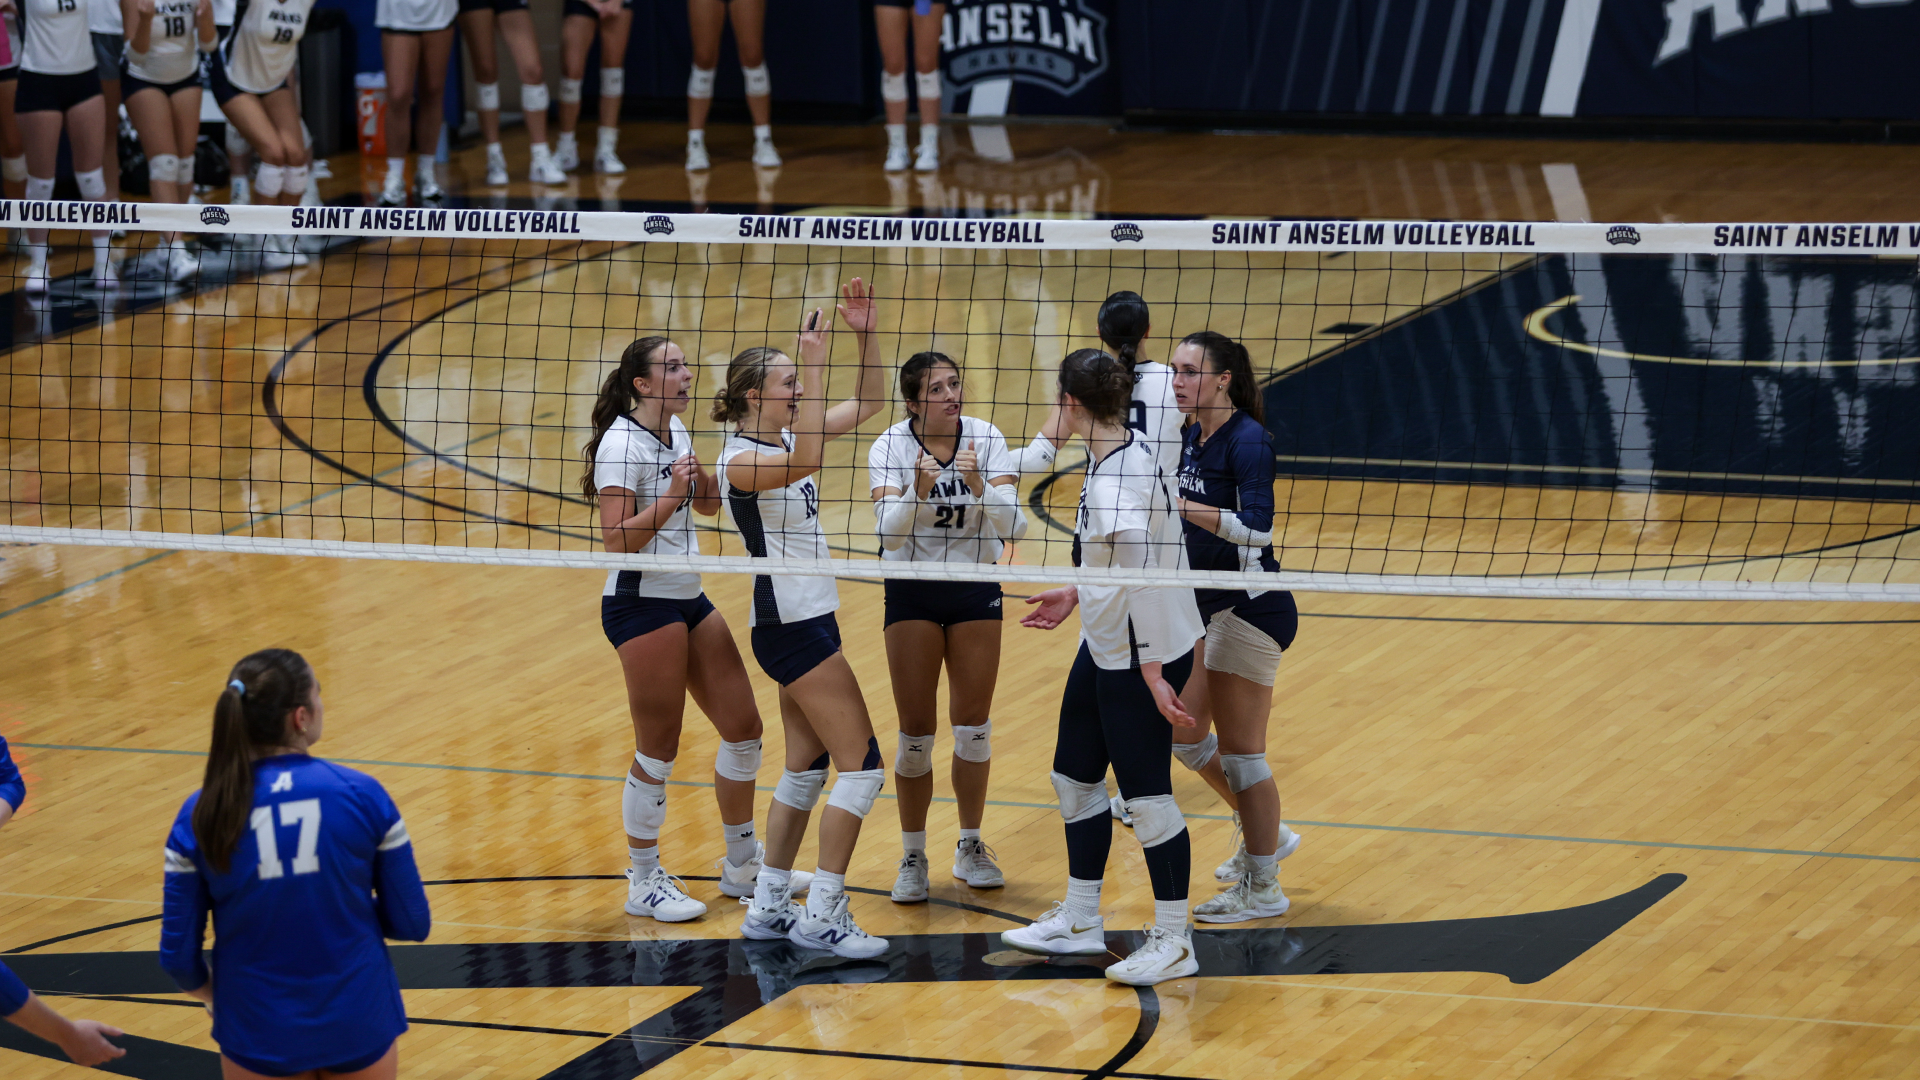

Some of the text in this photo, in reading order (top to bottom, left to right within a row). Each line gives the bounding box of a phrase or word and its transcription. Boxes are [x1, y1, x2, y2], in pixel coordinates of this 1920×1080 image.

[164, 16, 185, 37] 18
[19, 203, 140, 224] VOLLEYBALL
[292, 208, 581, 233] SAINT ANSELM VOLLEYBALL
[739, 217, 1044, 243] SAINT ANSELM VOLLEYBALL
[1212, 223, 1535, 246] SAINT ANSELM VOLLEYBALL
[1714, 225, 1788, 247] SAINT
[1795, 225, 1899, 248] ANSELM
[933, 504, 966, 529] 21
[250, 798, 321, 880] 17
